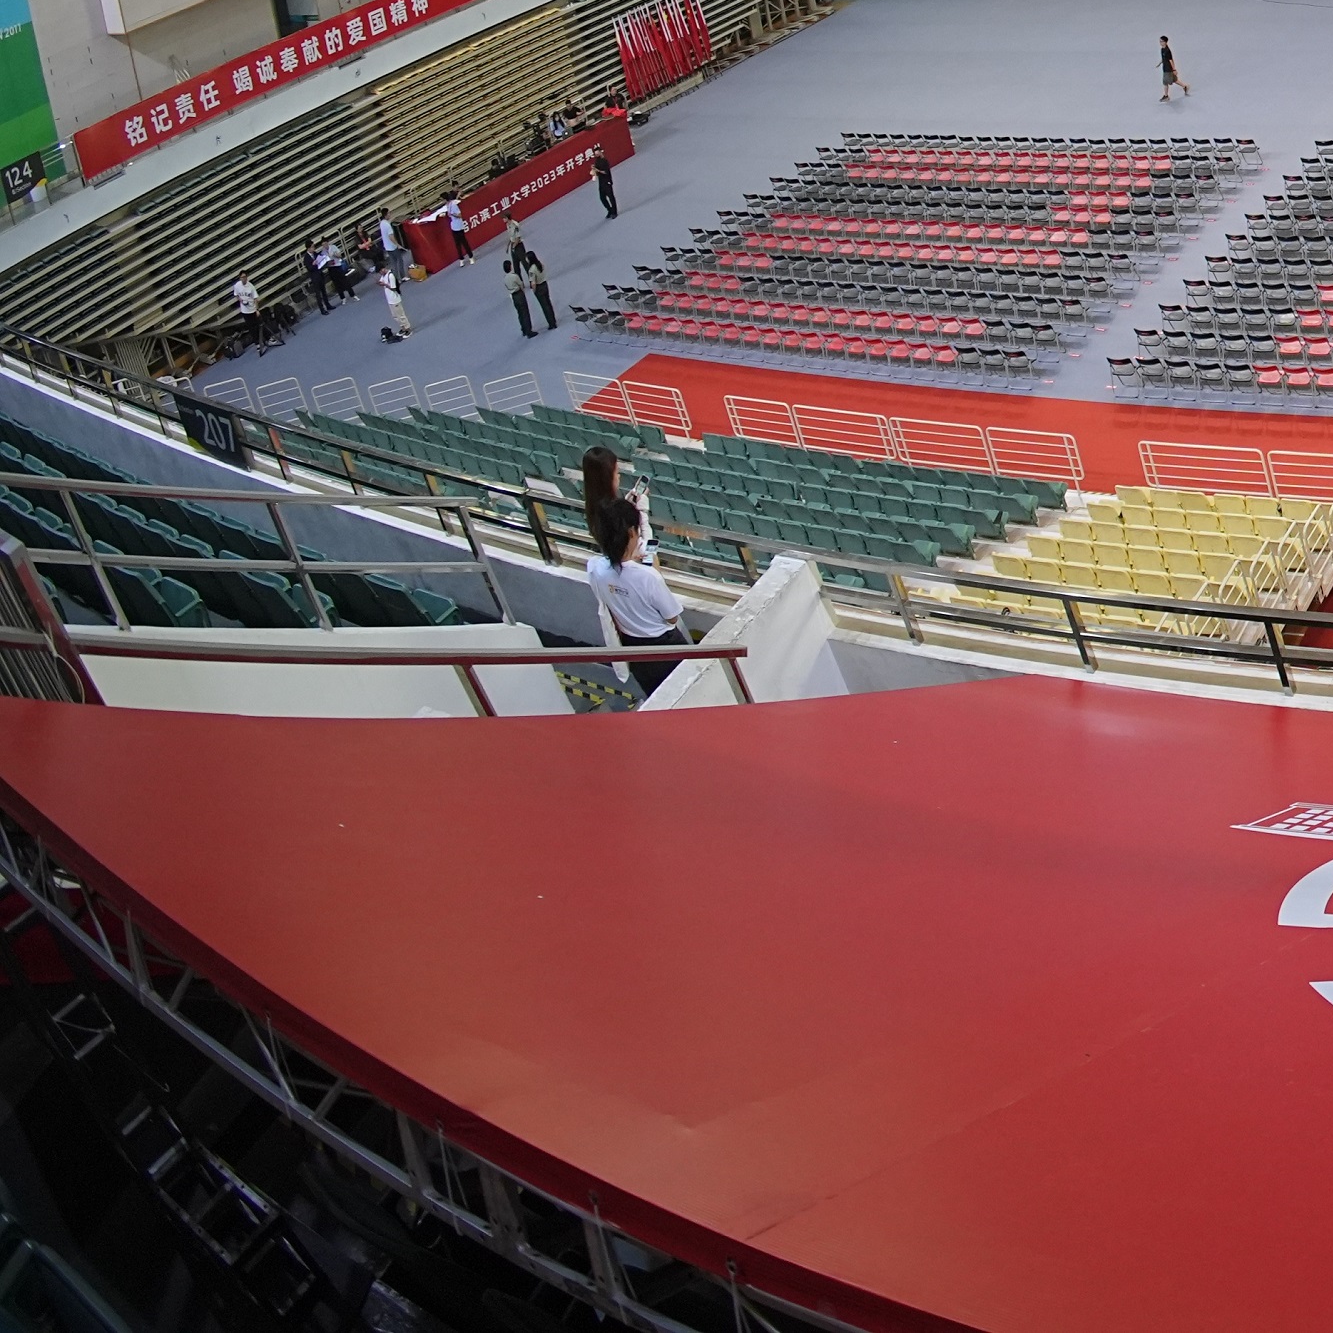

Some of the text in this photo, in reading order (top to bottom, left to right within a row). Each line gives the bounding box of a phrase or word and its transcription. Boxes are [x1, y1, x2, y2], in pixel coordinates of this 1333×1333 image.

[3, 23, 22, 39] 2011
[124, 80, 220, 147] 铭记责任
[5, 160, 33, 188] 124
[195, 409, 235, 452] 207
